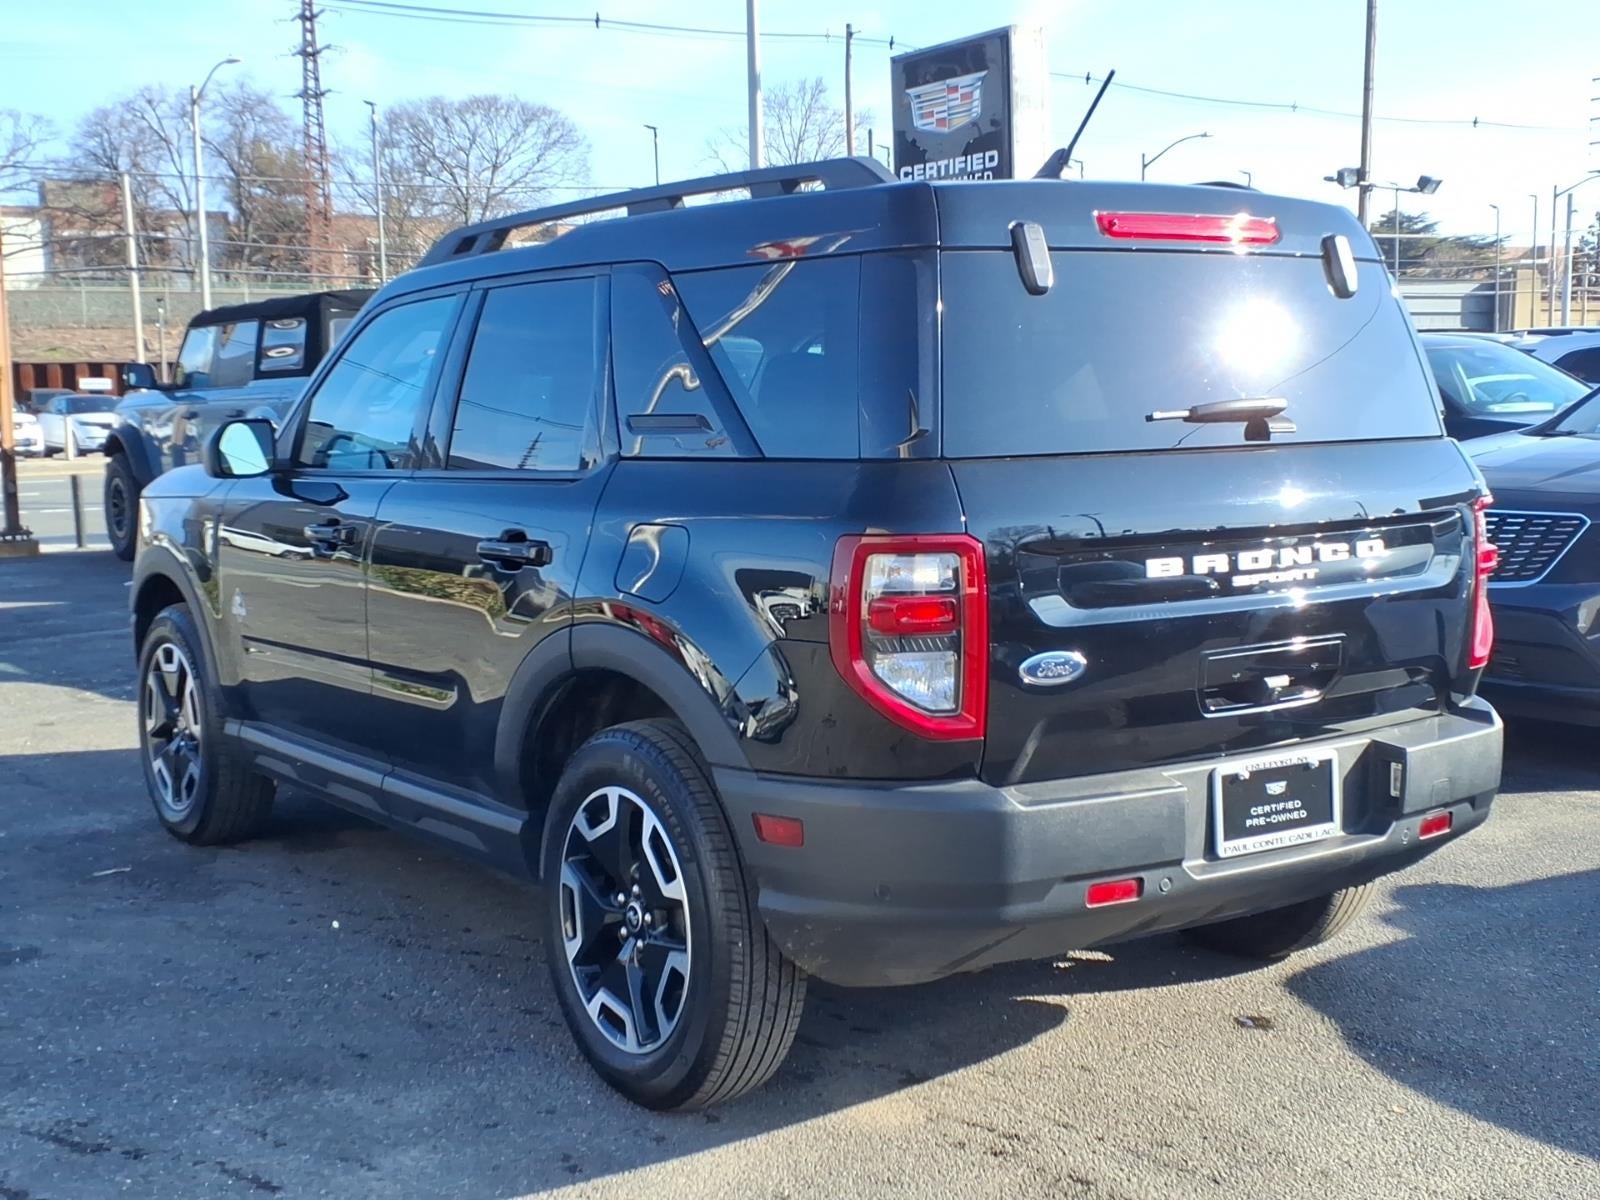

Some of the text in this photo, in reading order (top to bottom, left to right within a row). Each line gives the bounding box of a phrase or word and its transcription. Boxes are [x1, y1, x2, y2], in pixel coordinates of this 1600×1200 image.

[900, 150, 998, 181] CERTIFIED
[1145, 539, 1385, 578] BRONCO
[1232, 568, 1320, 587] SPORT
[1037, 658, 1073, 678] Ford
[1250, 800, 1302, 815] CERTIFIED
[1245, 810, 1308, 827] PRE-OWNED
[1224, 843, 1249, 855] PAUL
[1252, 836, 1286, 849] CONTE
